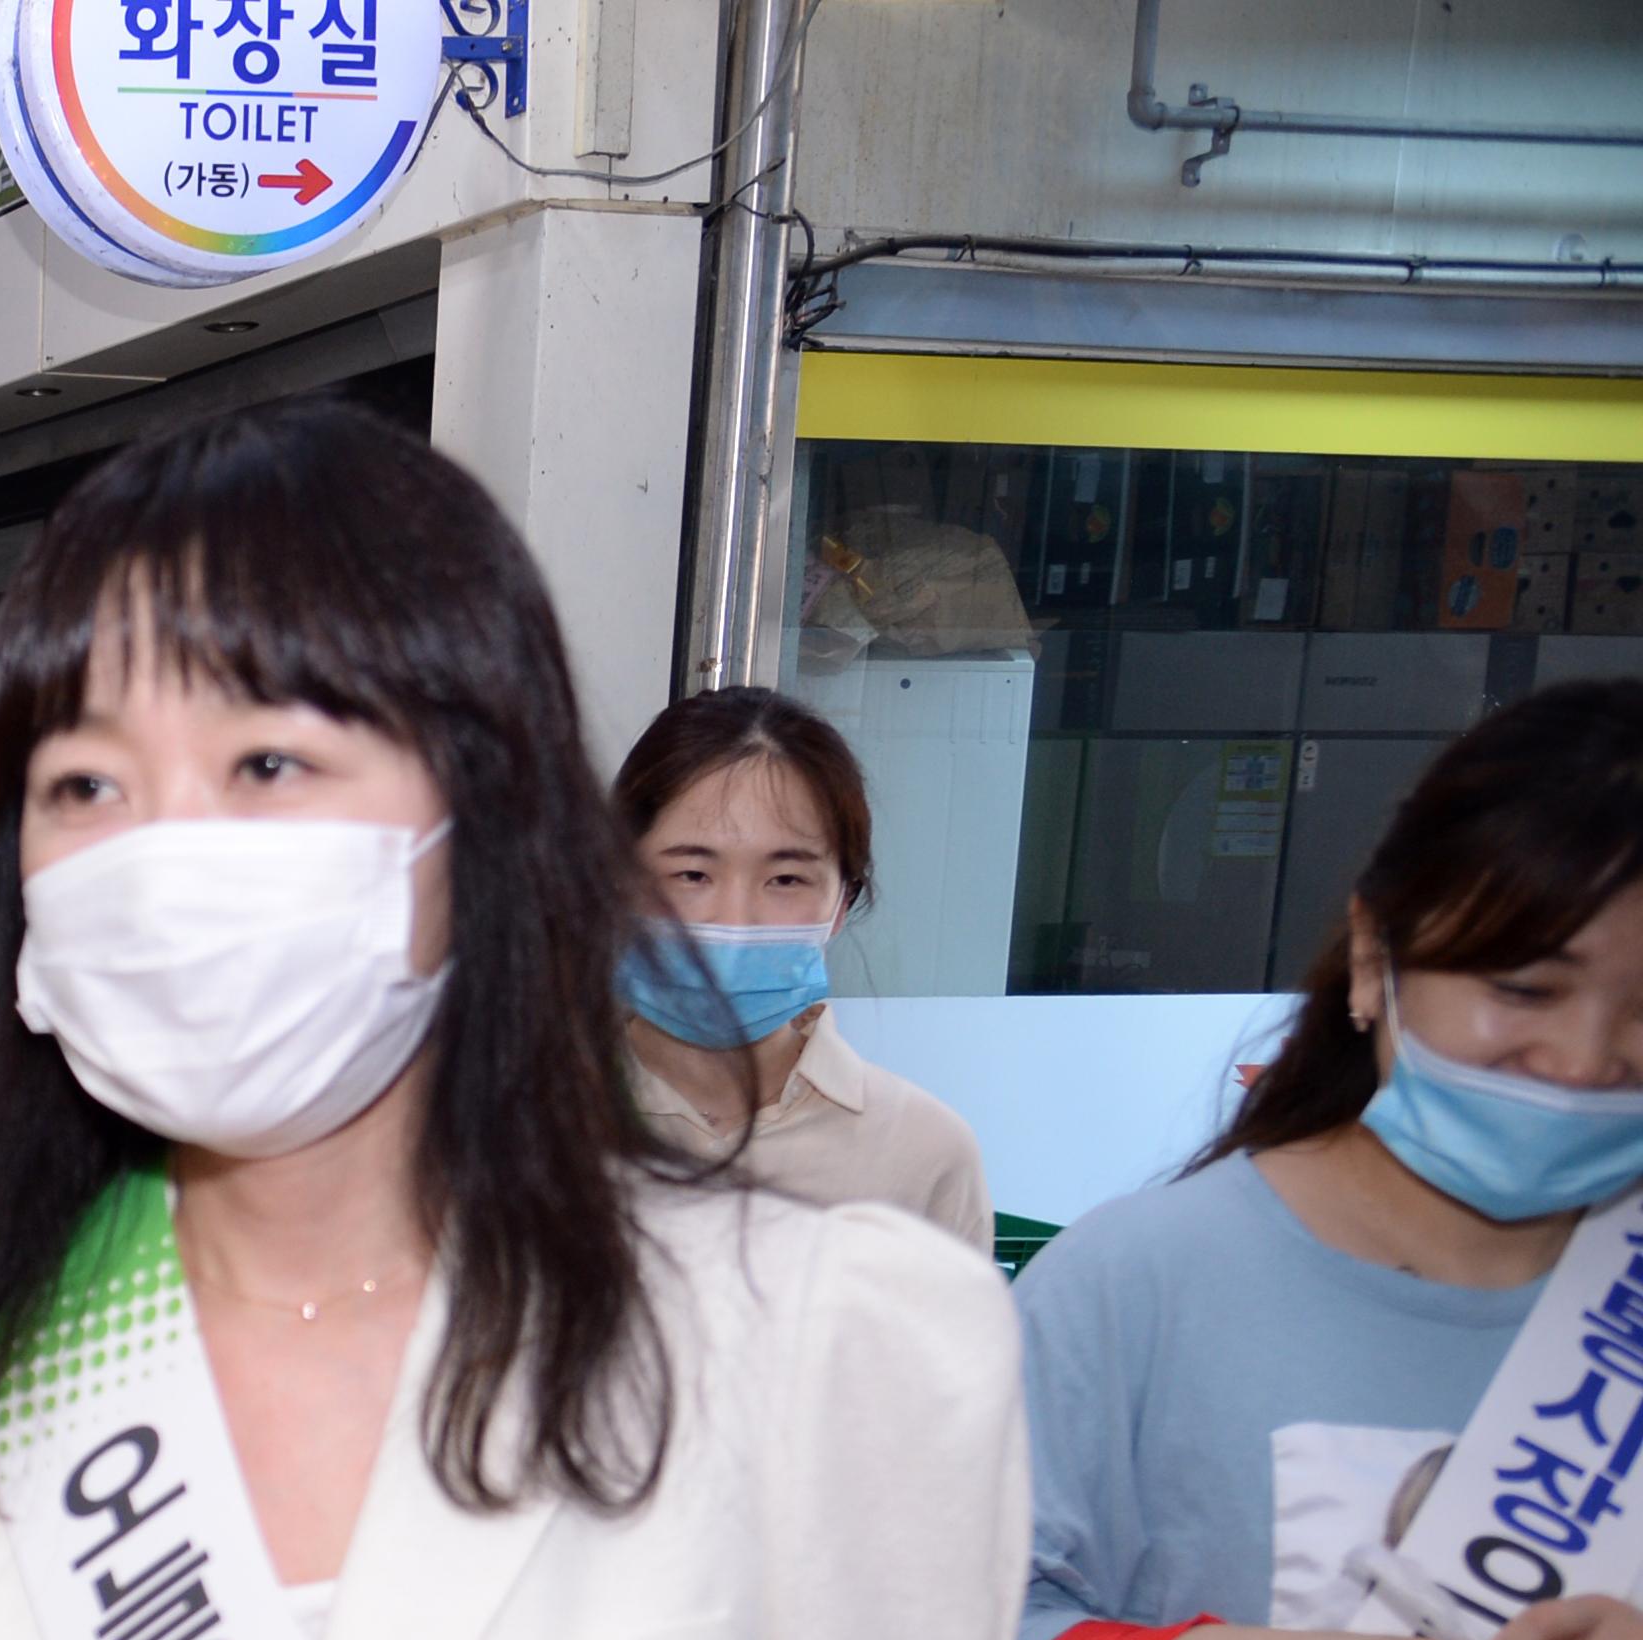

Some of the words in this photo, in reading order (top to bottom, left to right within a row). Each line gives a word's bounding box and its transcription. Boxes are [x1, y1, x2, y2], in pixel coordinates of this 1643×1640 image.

[118, 0, 377, 87] 화장실
[179, 102, 319, 143] TOILET
[163, 161, 250, 199] (가동)
